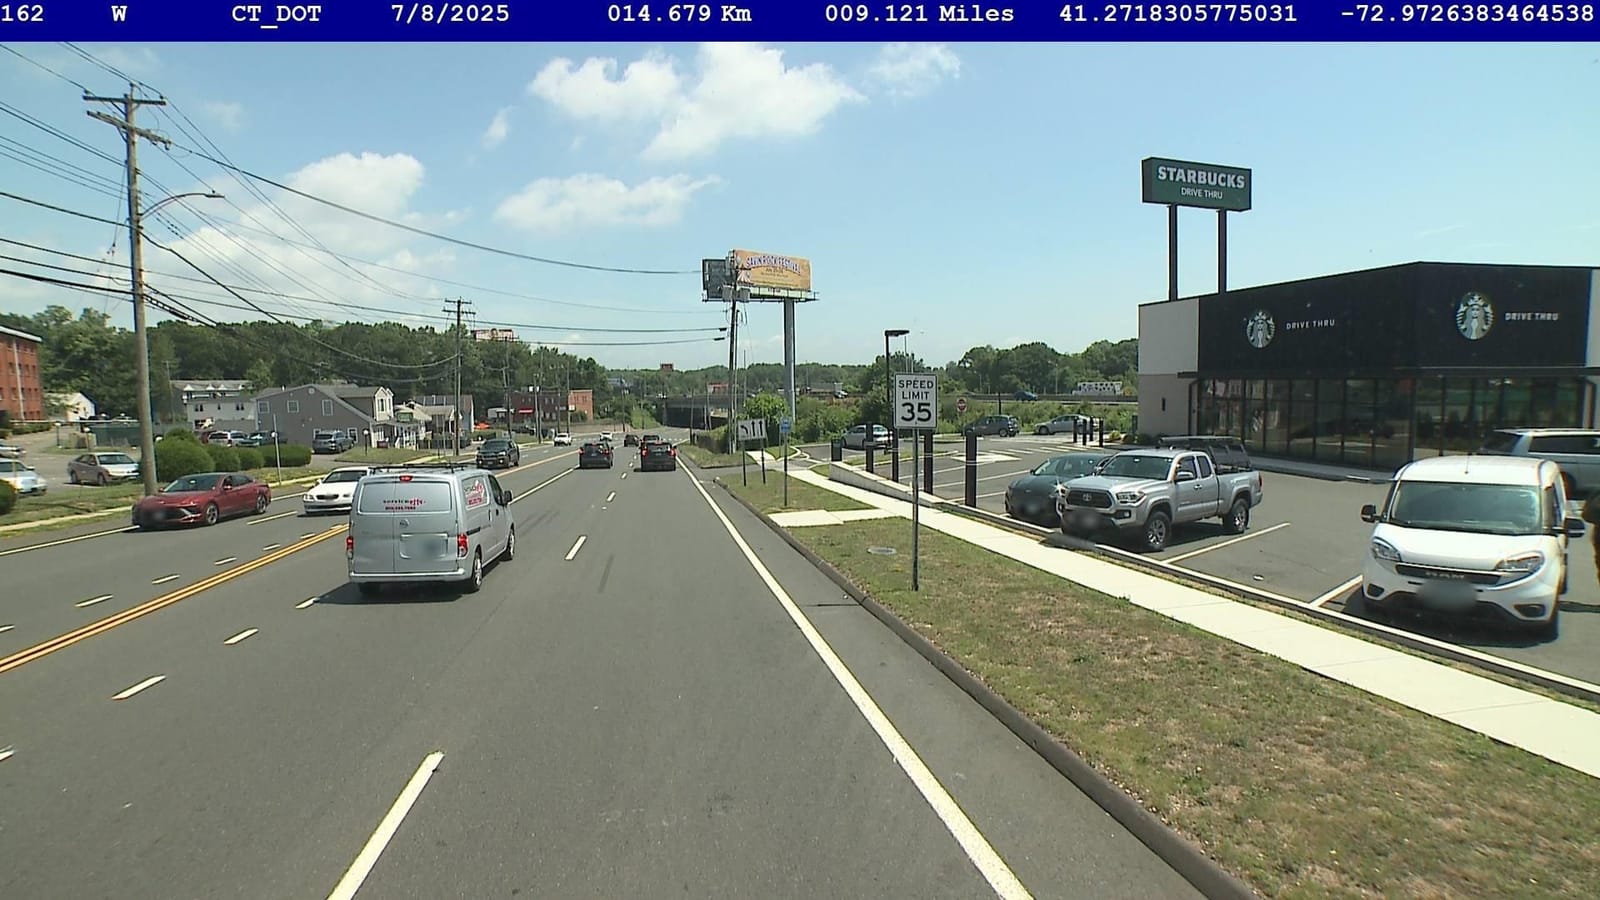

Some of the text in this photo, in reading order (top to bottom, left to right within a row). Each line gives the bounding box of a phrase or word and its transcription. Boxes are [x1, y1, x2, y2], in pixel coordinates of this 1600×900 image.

[1158, 166, 1245, 189] STARBUCKS
[1181, 187, 1223, 200] DRIVE THRU
[778, 255, 801, 274] FESTIVAL
[1505, 312, 1559, 321] DRIVE THRU
[1286, 319, 1335, 330] DRIVE THRU
[898, 380, 934, 389] SPEED
[902, 391, 930, 400] LIMIT
[901, 402, 932, 422] 35
